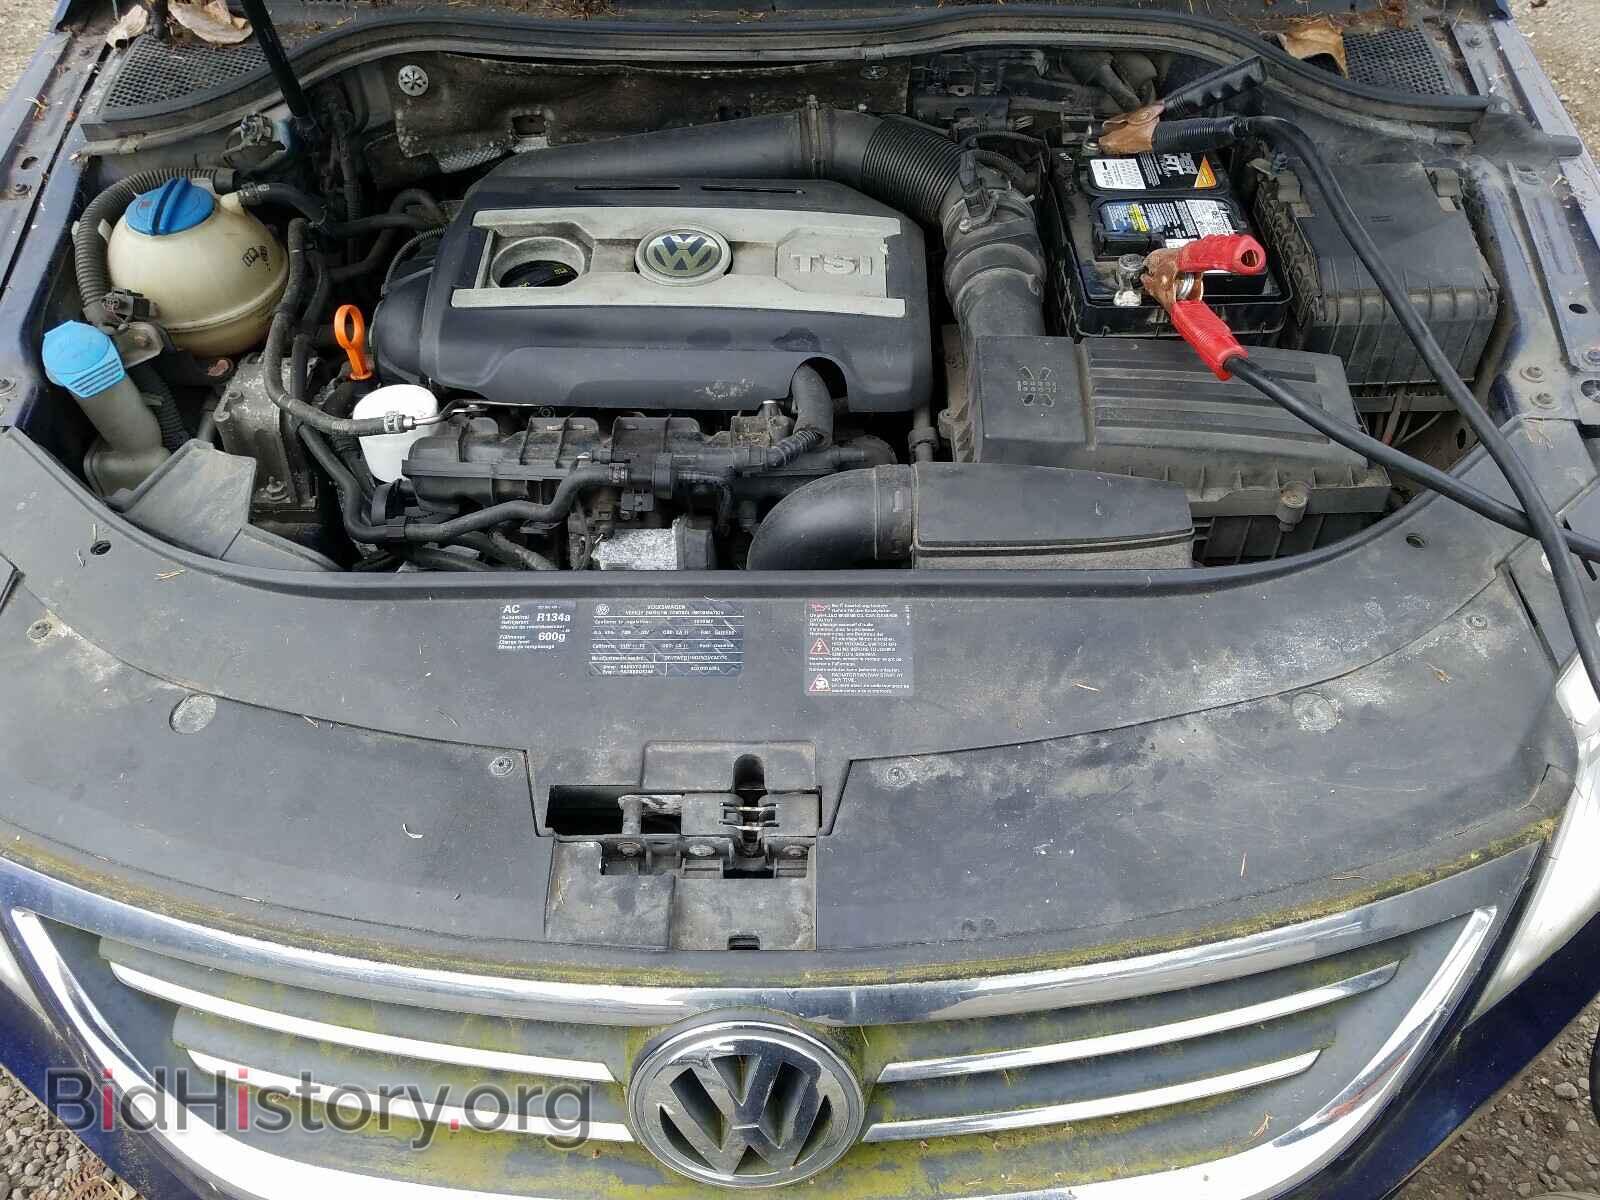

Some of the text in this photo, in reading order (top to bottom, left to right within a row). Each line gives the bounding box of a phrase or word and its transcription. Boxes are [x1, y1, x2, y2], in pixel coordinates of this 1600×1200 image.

[790, 254, 873, 276] TSI
[503, 604, 520, 613] AC
[537, 612, 571, 622] R134a
[538, 631, 566, 643] 600g
